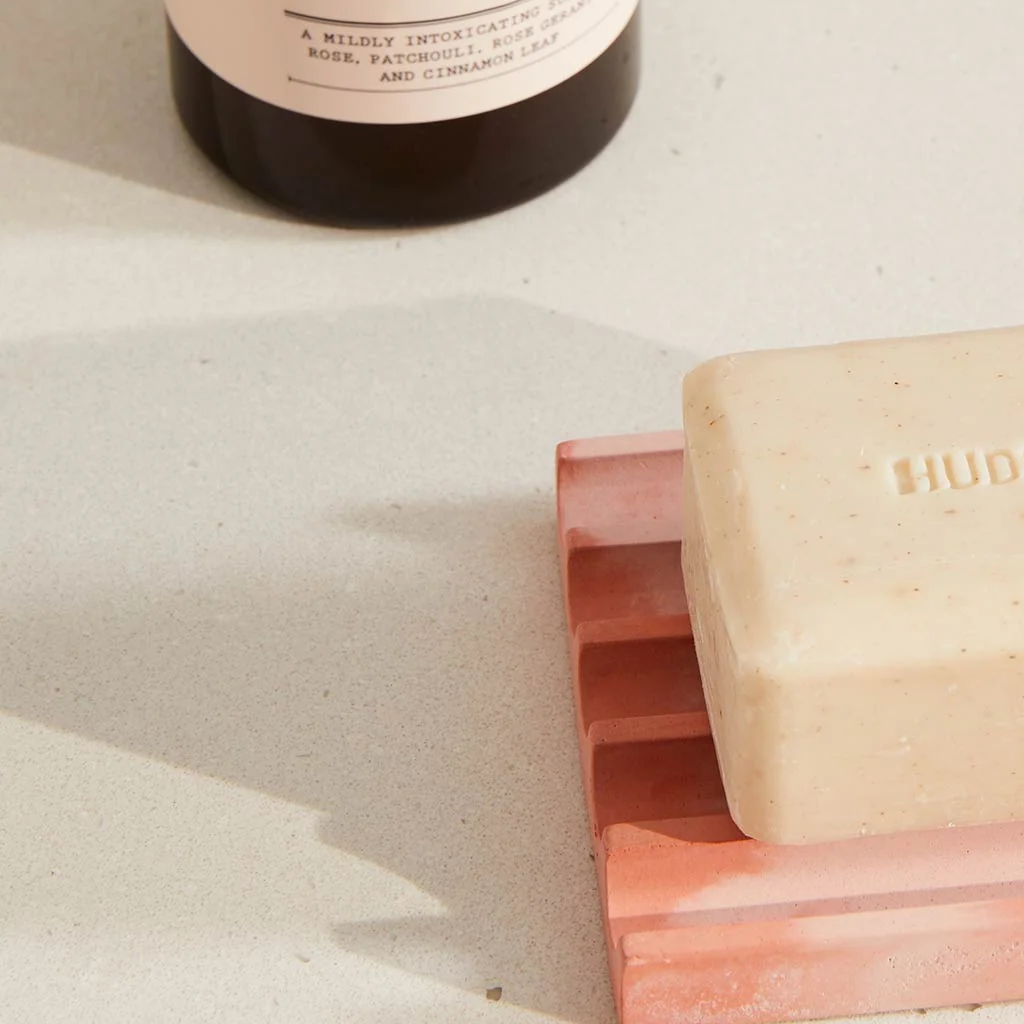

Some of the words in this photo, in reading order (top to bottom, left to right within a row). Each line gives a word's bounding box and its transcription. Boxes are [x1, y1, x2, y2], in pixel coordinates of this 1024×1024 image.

[301, 29, 312, 40] A
[323, 32, 395, 47] MILDLY
[407, 6, 540, 46] INTOXICATING
[492, 26, 535, 49] ROSE
[380, 71, 415, 82] AND
[423, 50, 514, 80] CINNAMON
[521, 31, 560, 57] LEAF
